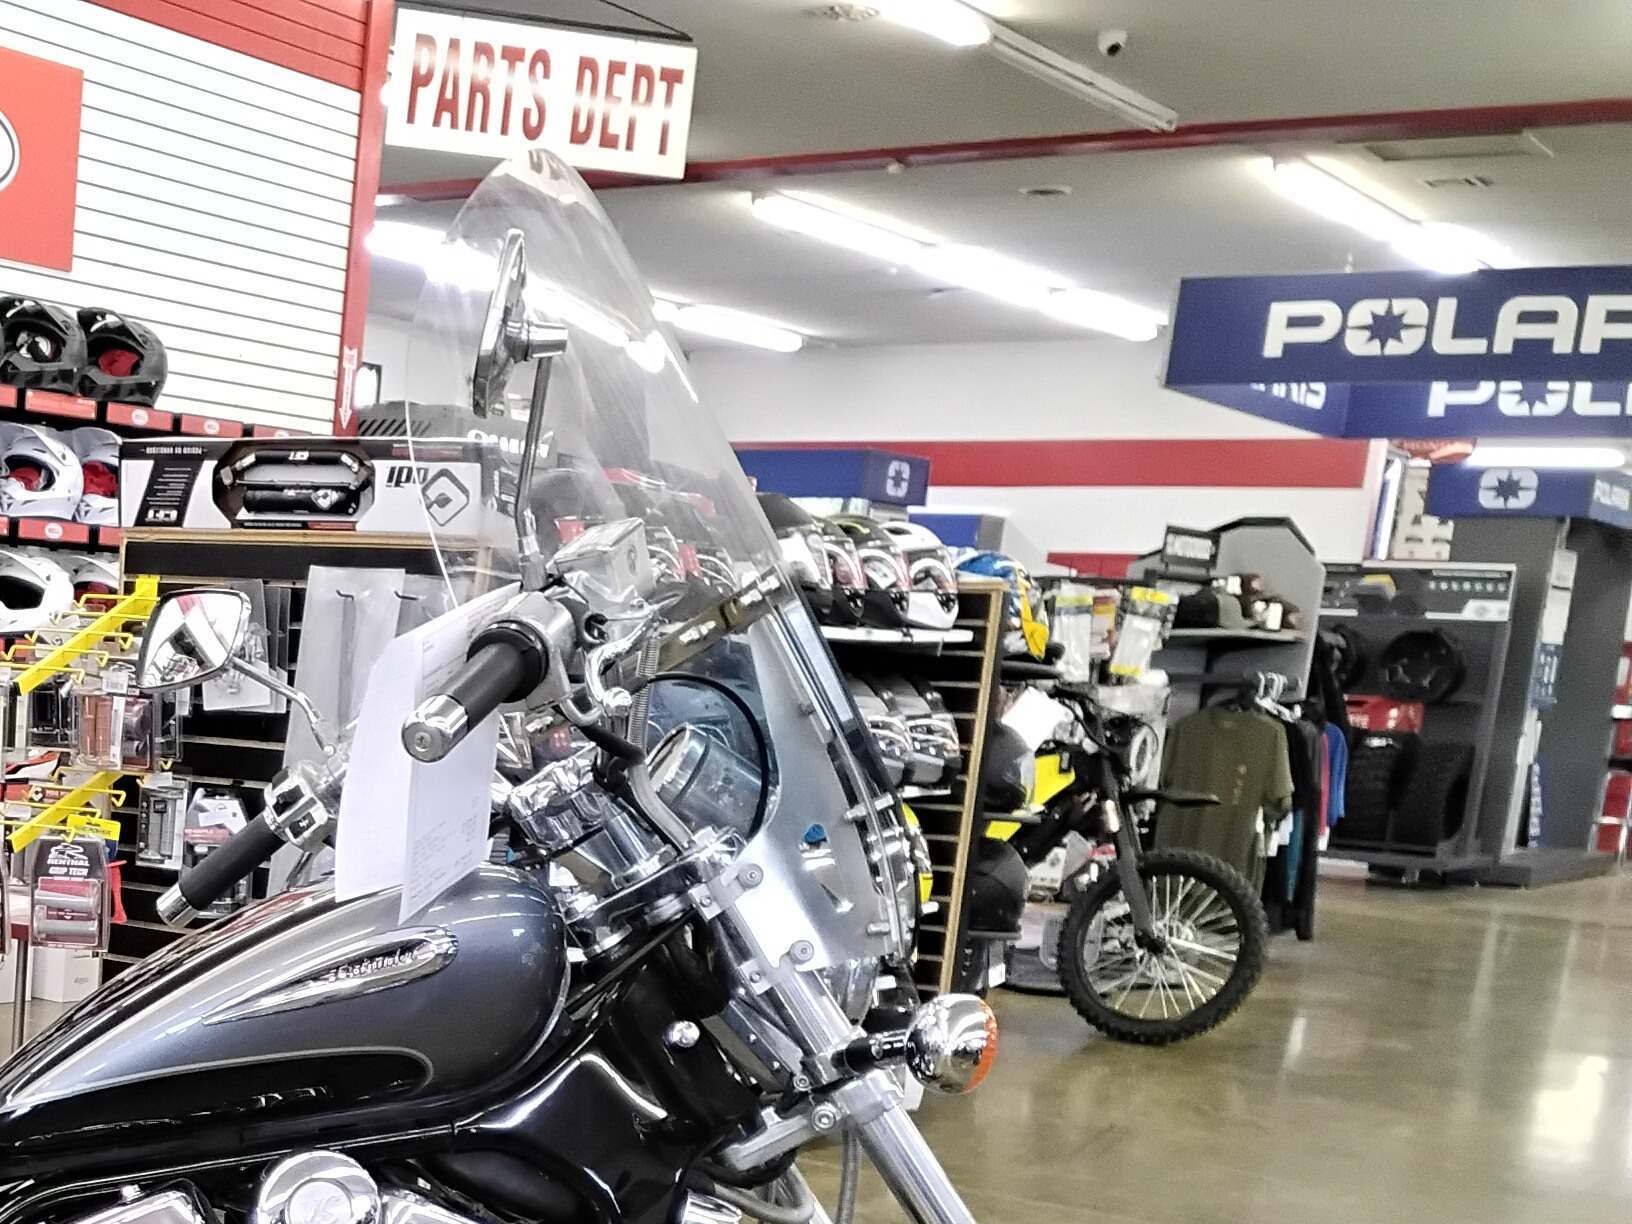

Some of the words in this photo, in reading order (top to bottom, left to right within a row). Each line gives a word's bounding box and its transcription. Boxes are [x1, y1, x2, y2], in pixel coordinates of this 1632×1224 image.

[406, 33, 551, 141] PARTS
[569, 56, 685, 156] DEPT
[47, 858, 90, 867] RENTHAL
